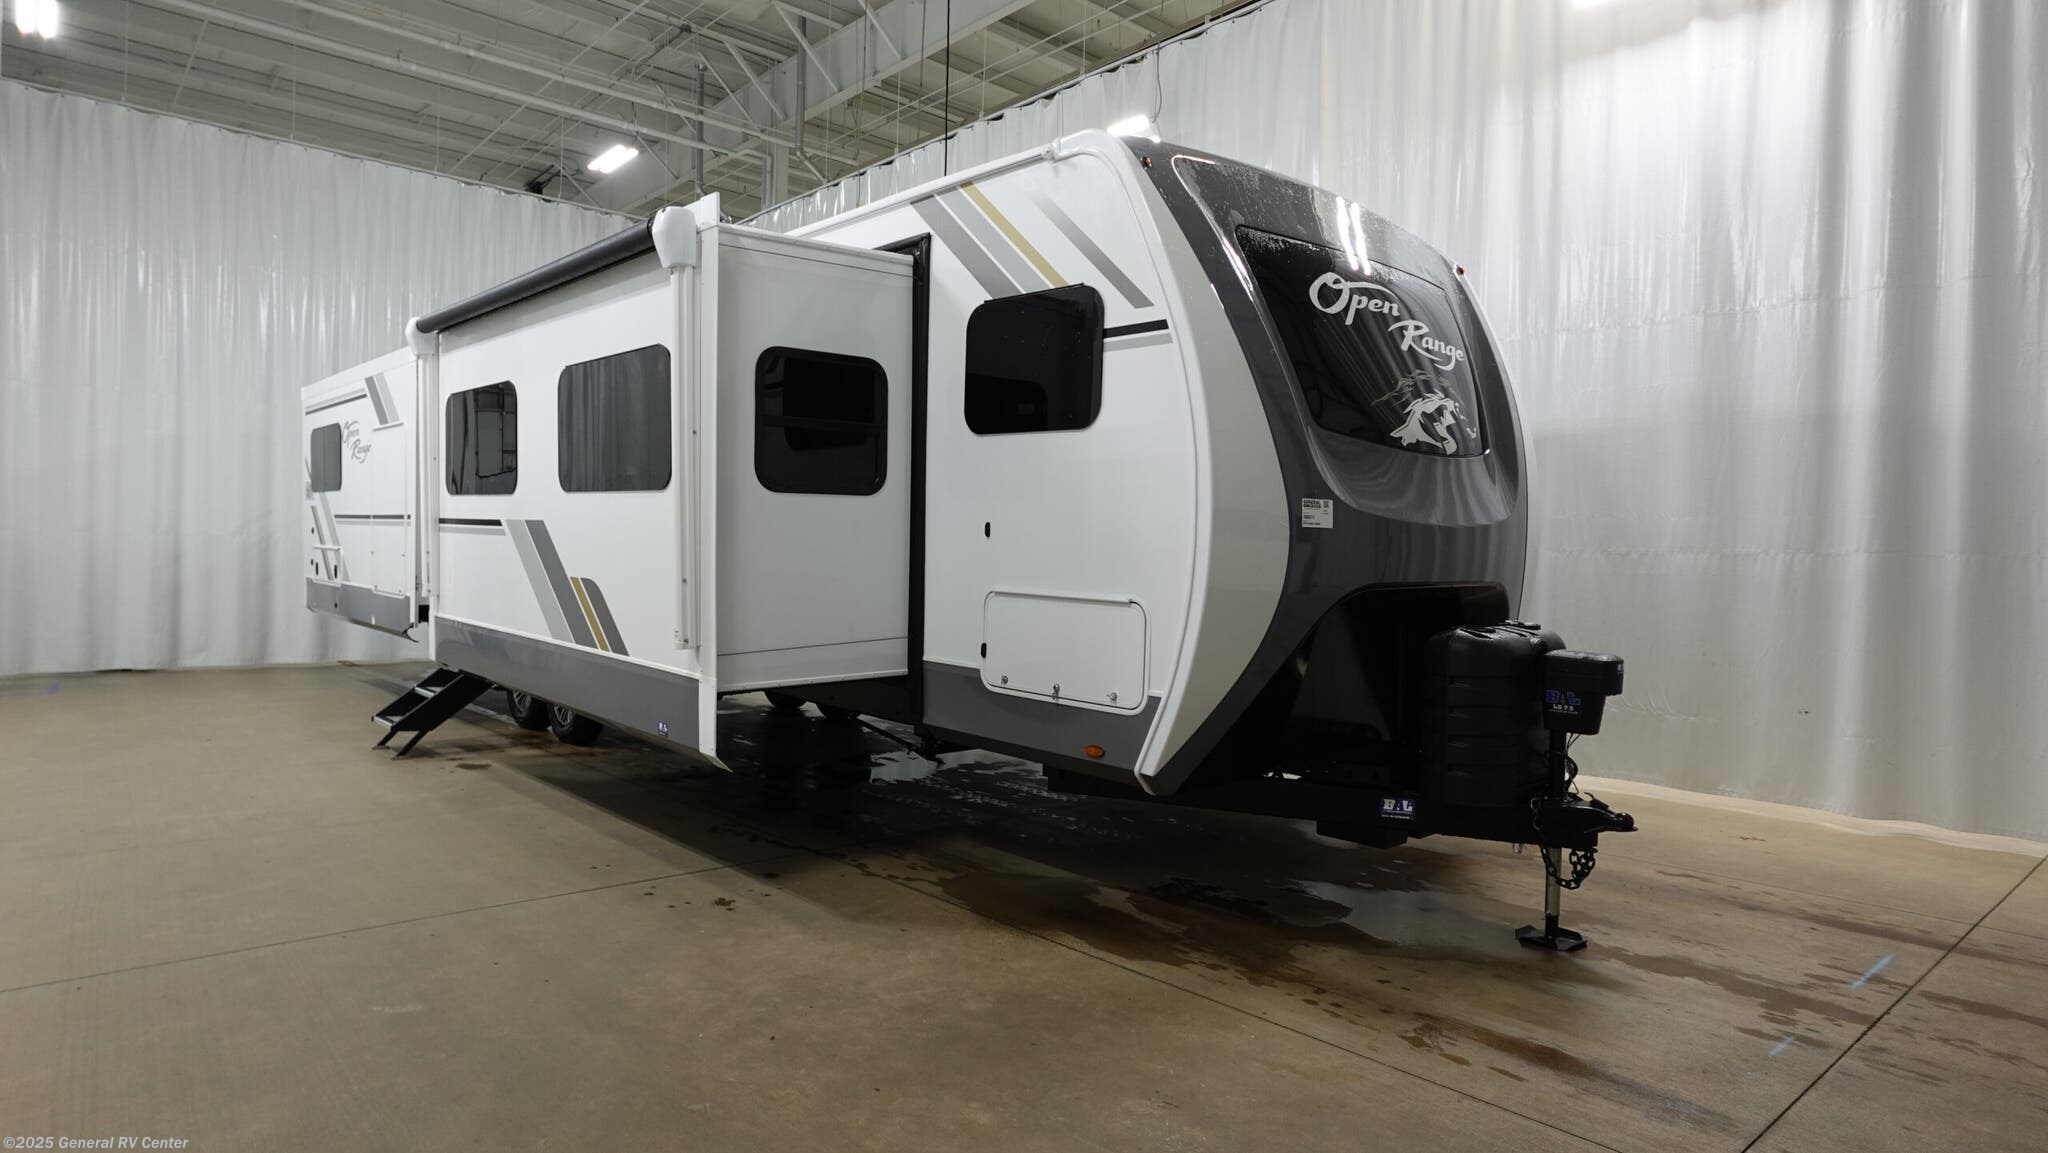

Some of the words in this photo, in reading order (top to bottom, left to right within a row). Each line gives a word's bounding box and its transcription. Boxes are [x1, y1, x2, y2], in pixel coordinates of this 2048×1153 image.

[1309, 272, 1401, 325] Open
[1387, 319, 1465, 371] Range
[350, 438, 371, 464] Range
